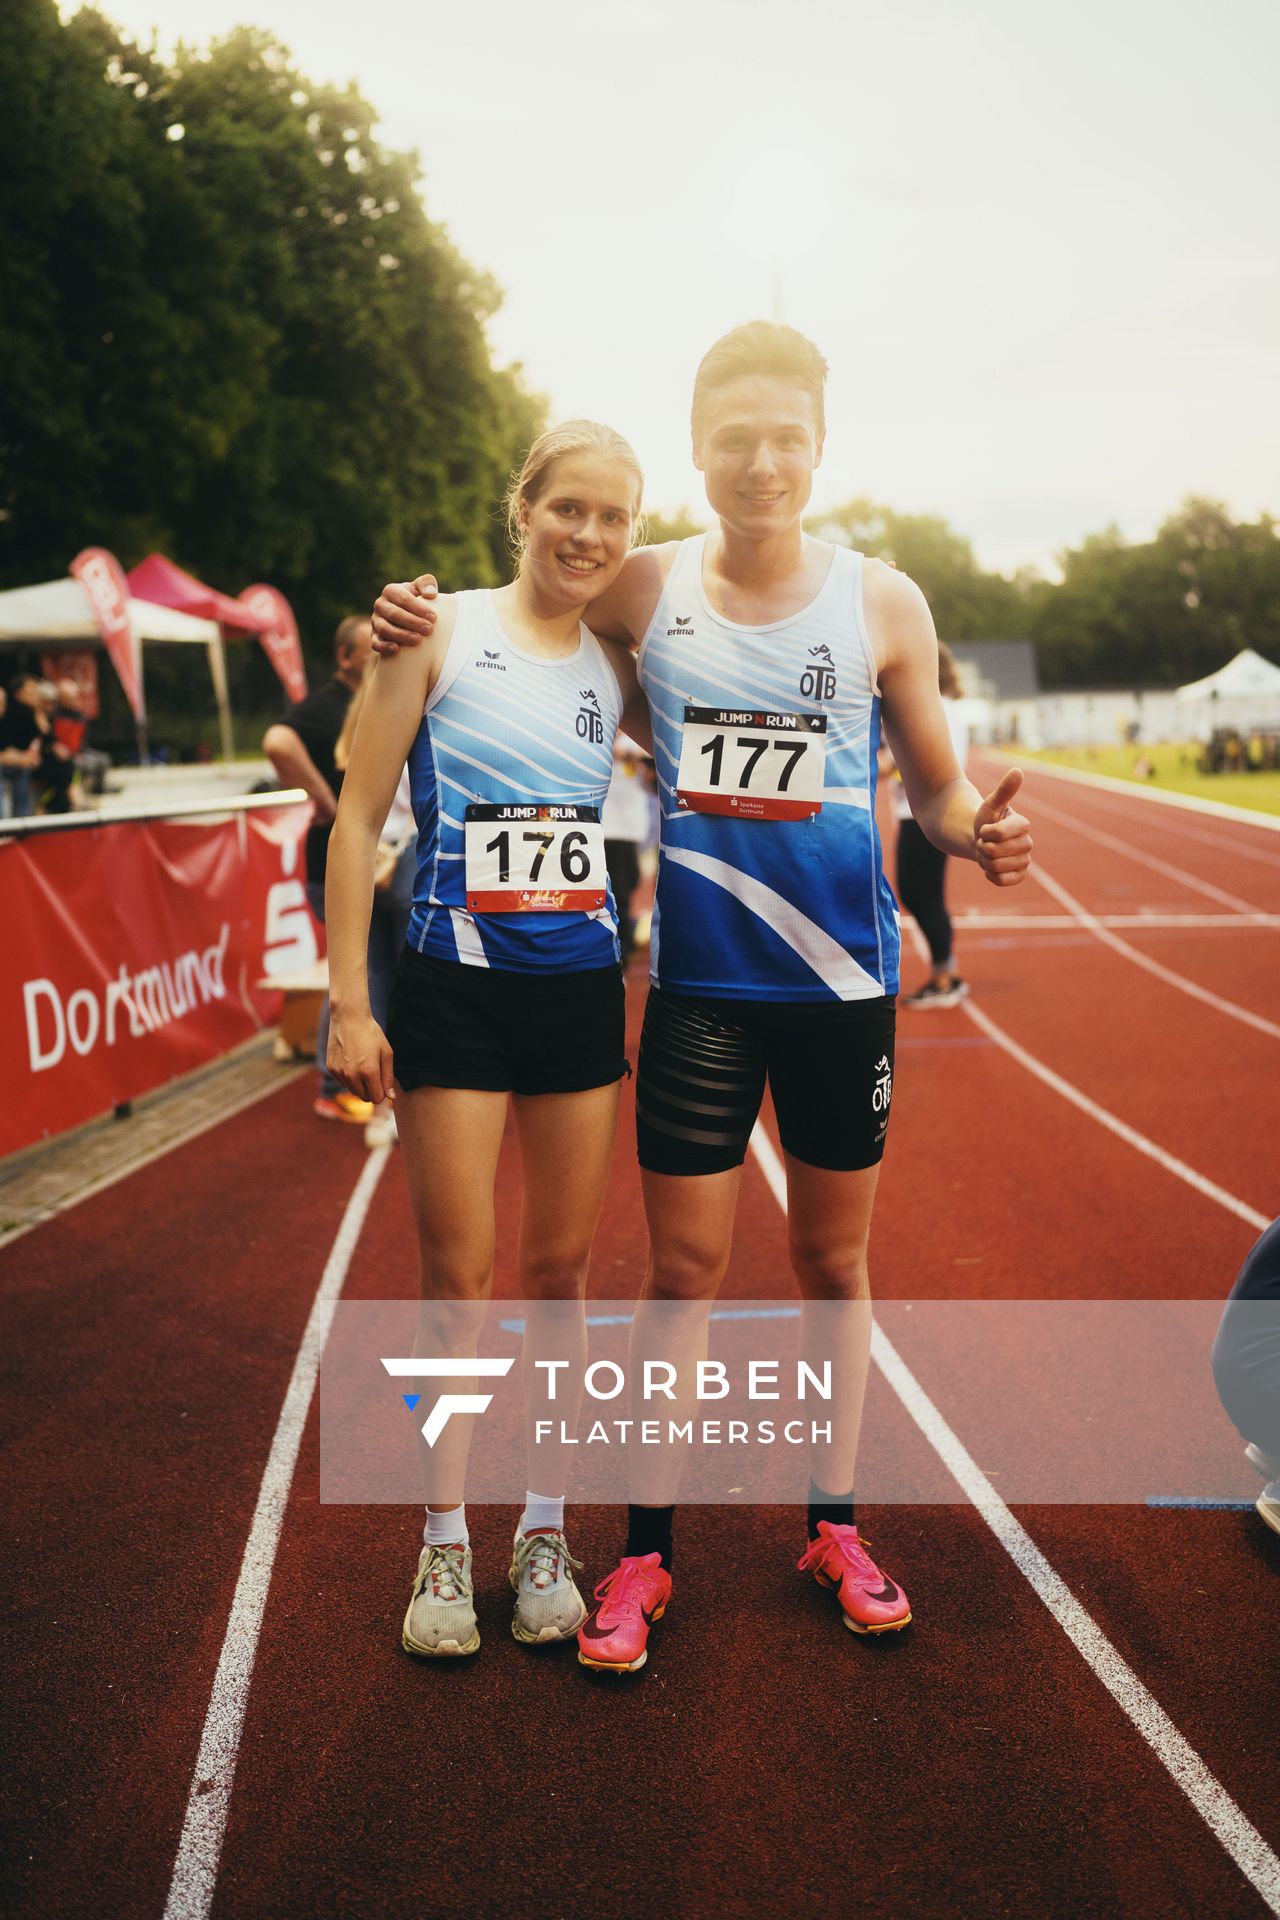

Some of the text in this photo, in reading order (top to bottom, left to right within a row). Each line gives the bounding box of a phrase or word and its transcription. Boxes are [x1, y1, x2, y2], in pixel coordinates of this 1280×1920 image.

[667, 627, 695, 636] erima
[475, 660, 507, 672] erima
[714, 712, 796, 728] JUMP N RUN
[701, 734, 808, 792] 177
[739, 801, 765, 809] Sparkasse
[497, 807, 537, 819] JUMP
[549, 808, 578, 819] RUN
[486, 831, 591, 884] 176
[23, 922, 231, 1073] Dortmund
